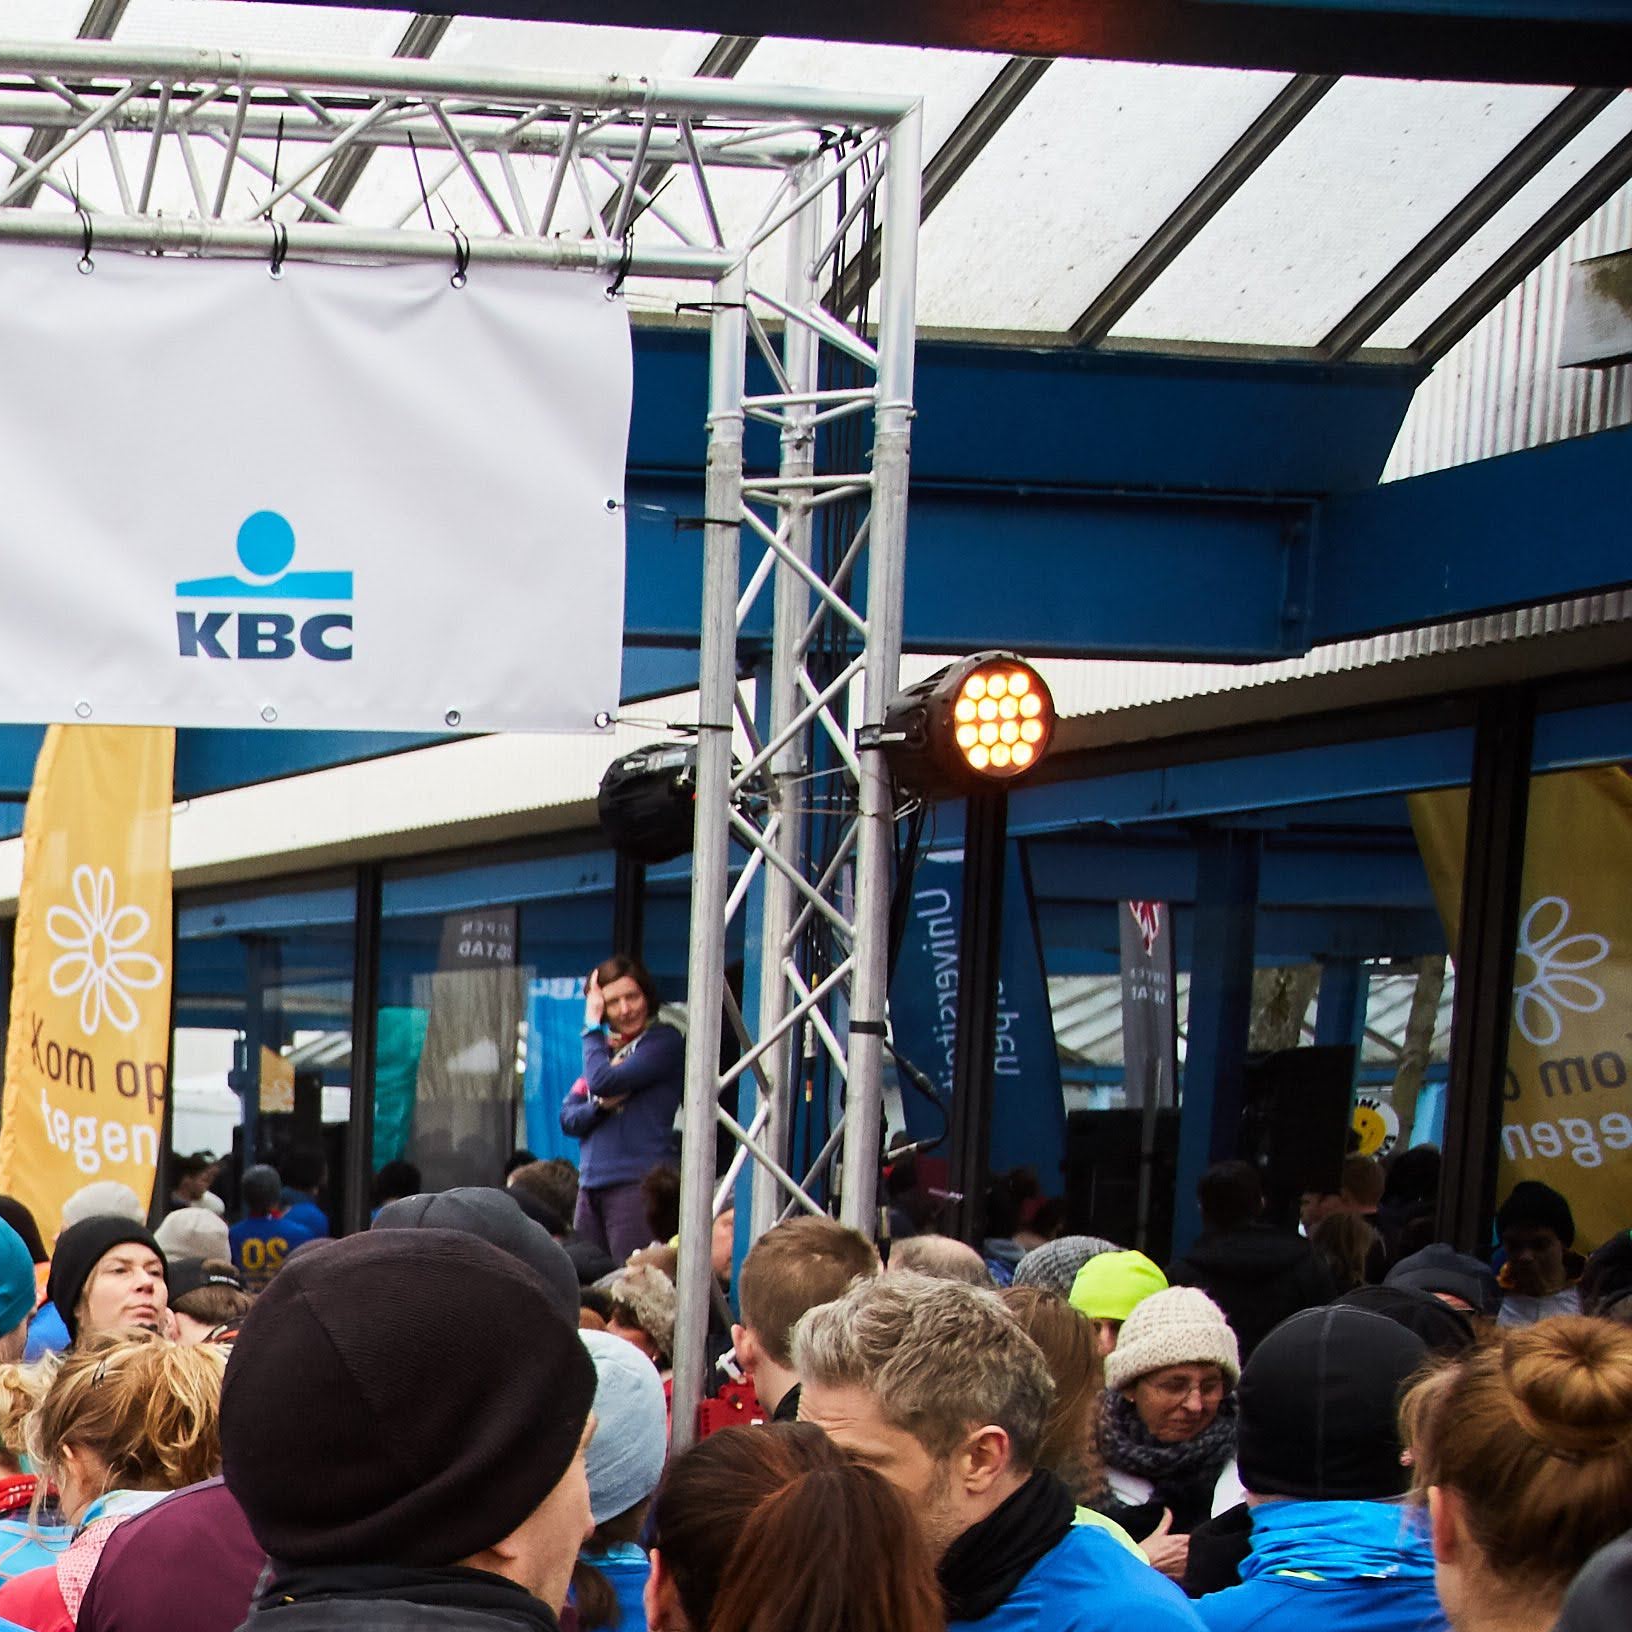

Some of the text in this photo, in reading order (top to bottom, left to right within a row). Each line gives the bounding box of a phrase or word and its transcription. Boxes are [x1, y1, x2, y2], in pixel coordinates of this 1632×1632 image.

[175, 610, 354, 662] KBC
[31, 1011, 167, 1115] Kom op
[40, 1087, 158, 1175] tegen
